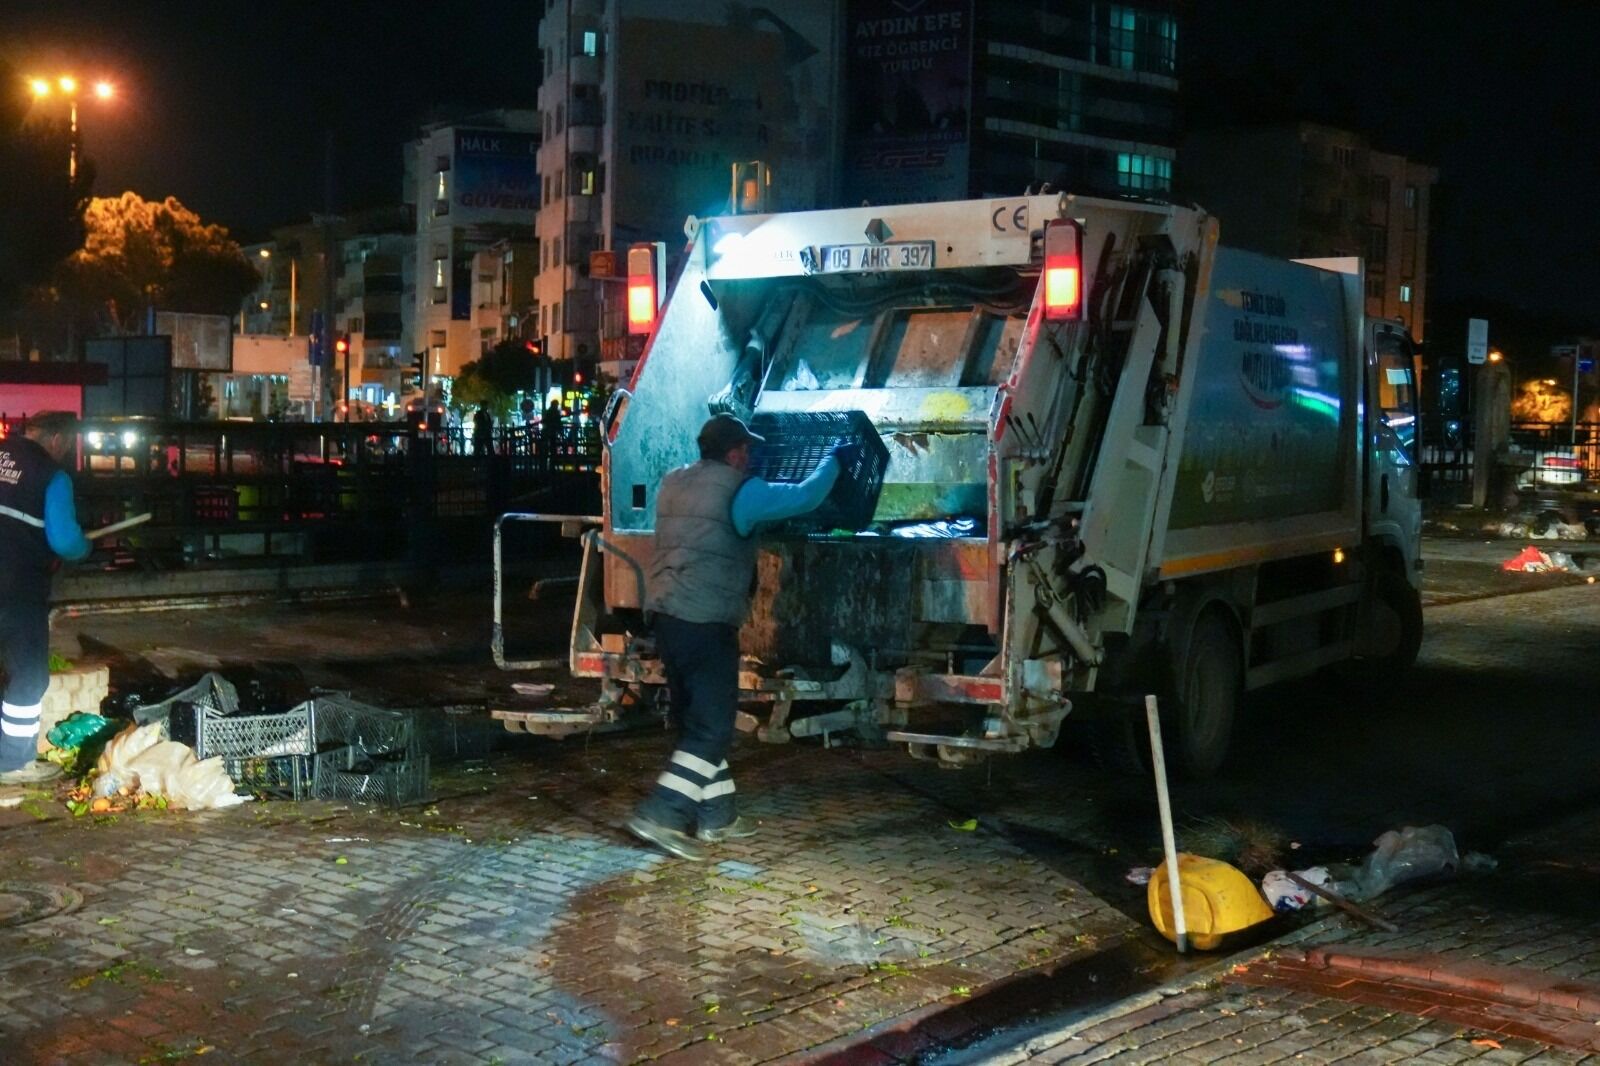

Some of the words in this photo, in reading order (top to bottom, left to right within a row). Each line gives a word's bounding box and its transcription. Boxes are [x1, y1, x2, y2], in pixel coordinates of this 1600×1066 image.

[855, 15, 919, 39] AYDIN
[924, 11, 962, 32] EFE
[460, 135, 501, 153] HALK
[992, 205, 1028, 232] CE
[832, 248, 851, 269] 09
[860, 248, 891, 269] AHR
[900, 246, 931, 267] 397
